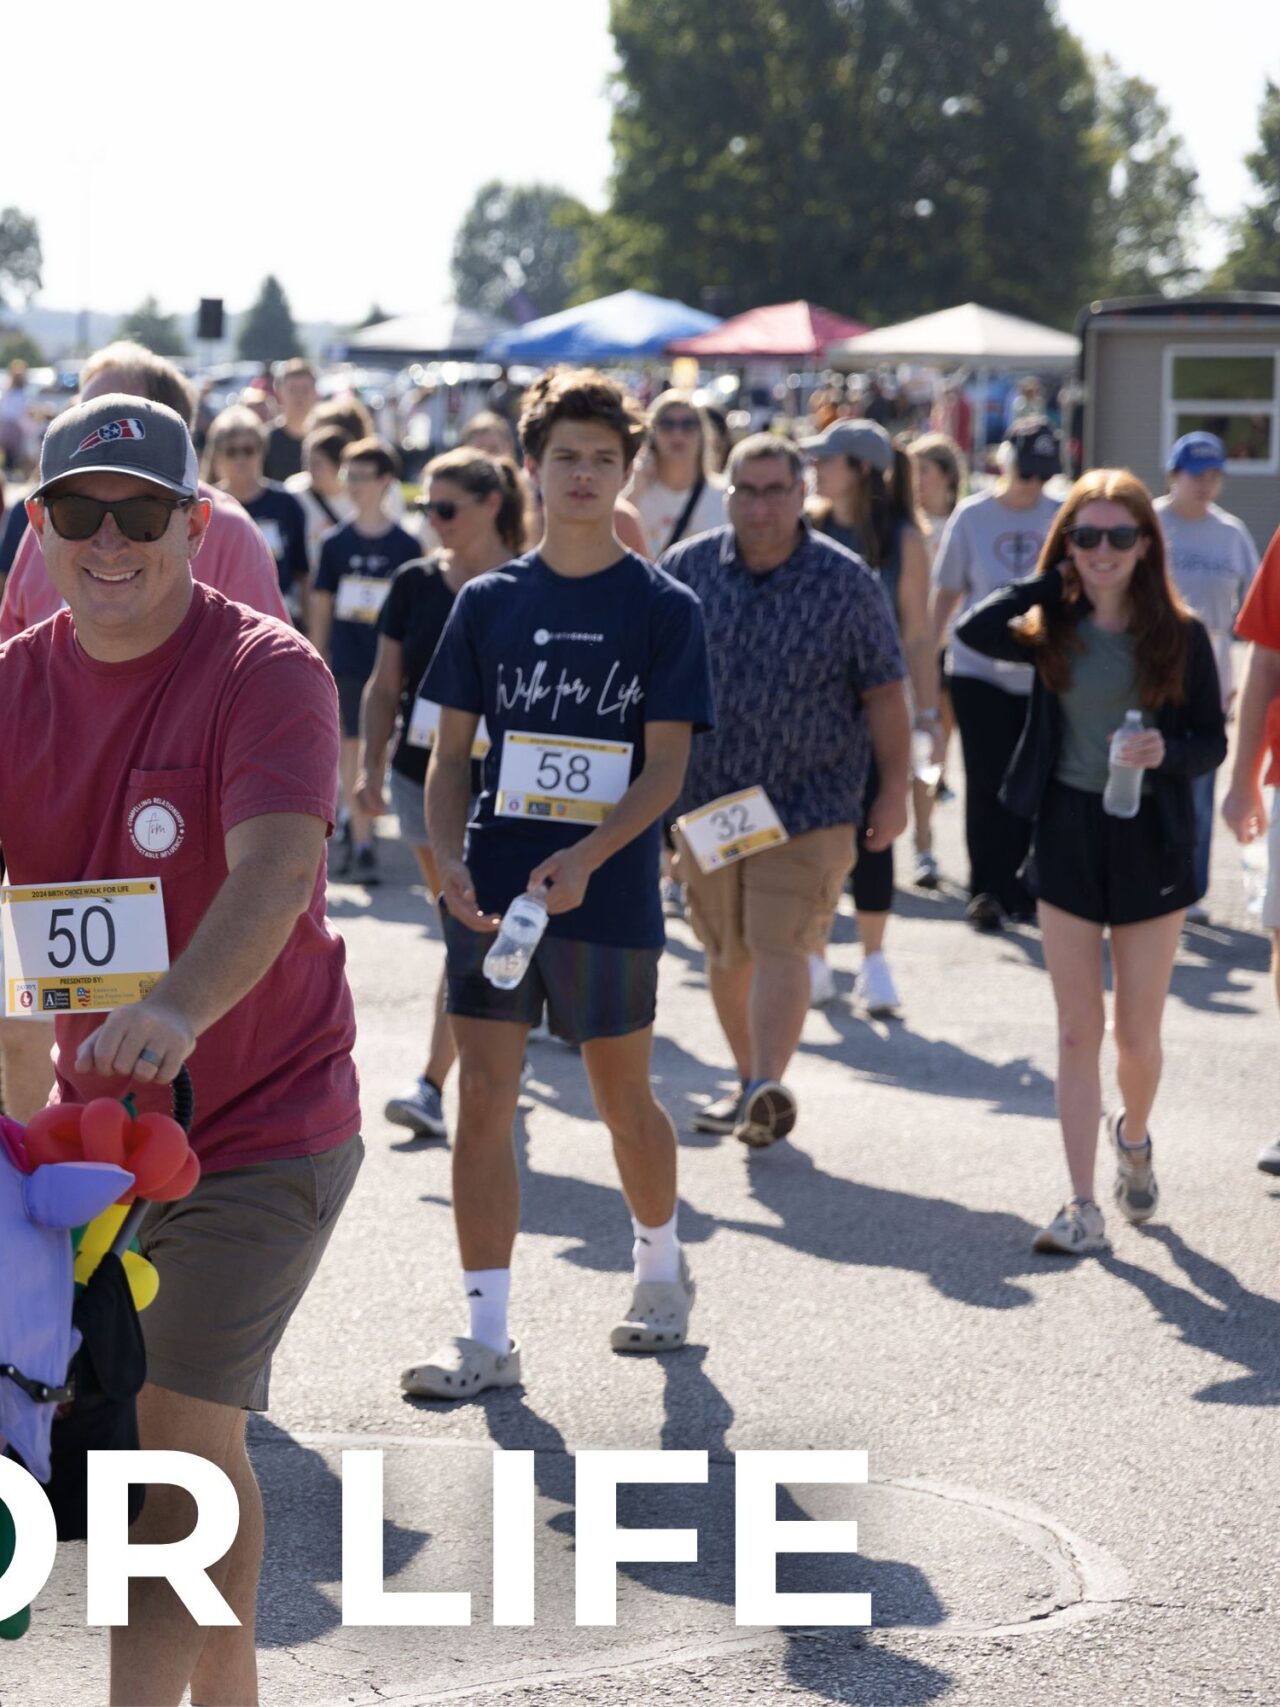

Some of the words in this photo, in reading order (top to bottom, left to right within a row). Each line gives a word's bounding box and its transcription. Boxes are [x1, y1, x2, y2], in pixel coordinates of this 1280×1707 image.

[495, 660, 551, 715] Walk
[551, 668, 591, 721] for
[597, 660, 645, 723] Life
[536, 751, 591, 793] 58
[709, 803, 756, 841] 32
[31, 890, 47, 898] 2024
[47, 889, 64, 897] BIRTH
[64, 888, 83, 896] CHOICE
[83, 887, 102, 895] WALK
[117, 885, 129, 893] LIFE
[47, 905, 116, 969] 50
[59, 977, 92, 985] PRESENTED
